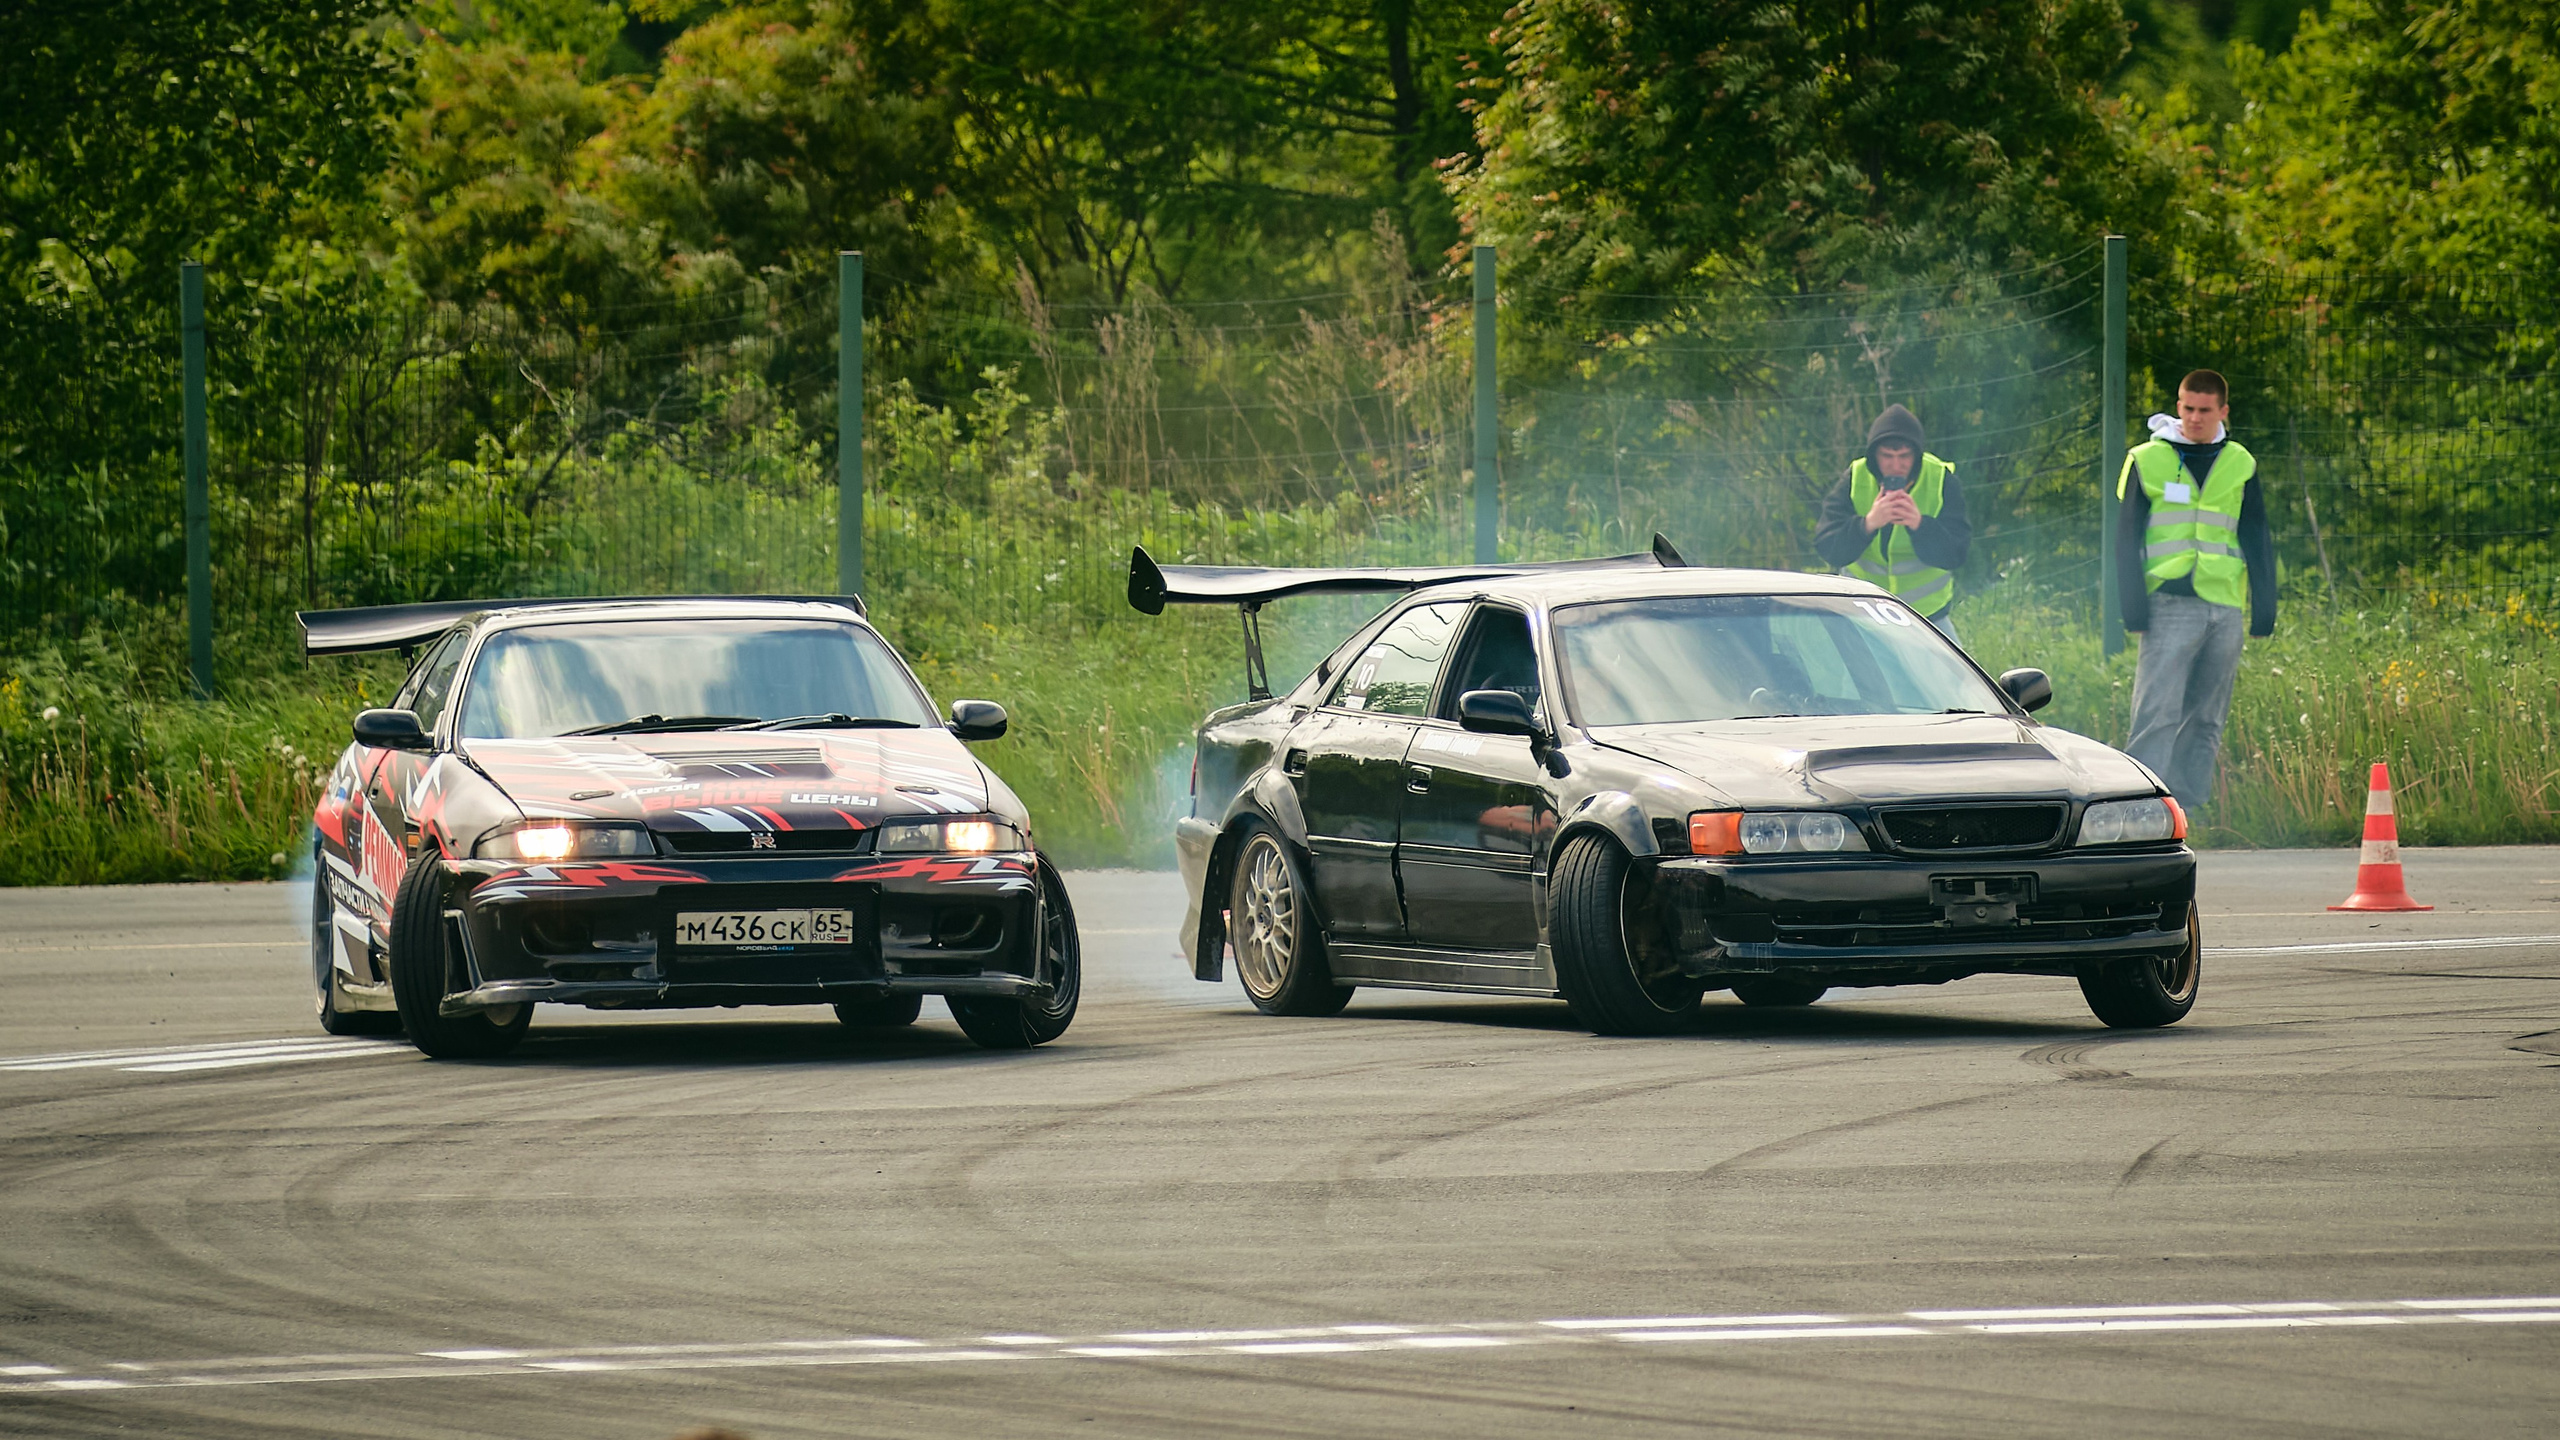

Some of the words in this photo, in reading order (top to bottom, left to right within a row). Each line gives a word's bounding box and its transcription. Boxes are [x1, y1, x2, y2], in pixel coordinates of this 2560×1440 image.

[1853, 600, 1912, 627] 10
[1355, 663, 1375, 691] 10
[643, 790, 784, 813] ВЫШЕ
[790, 793, 878, 808] ЦЕНЫ
[814, 913, 842, 933] 65
[811, 932, 833, 941] RUS
